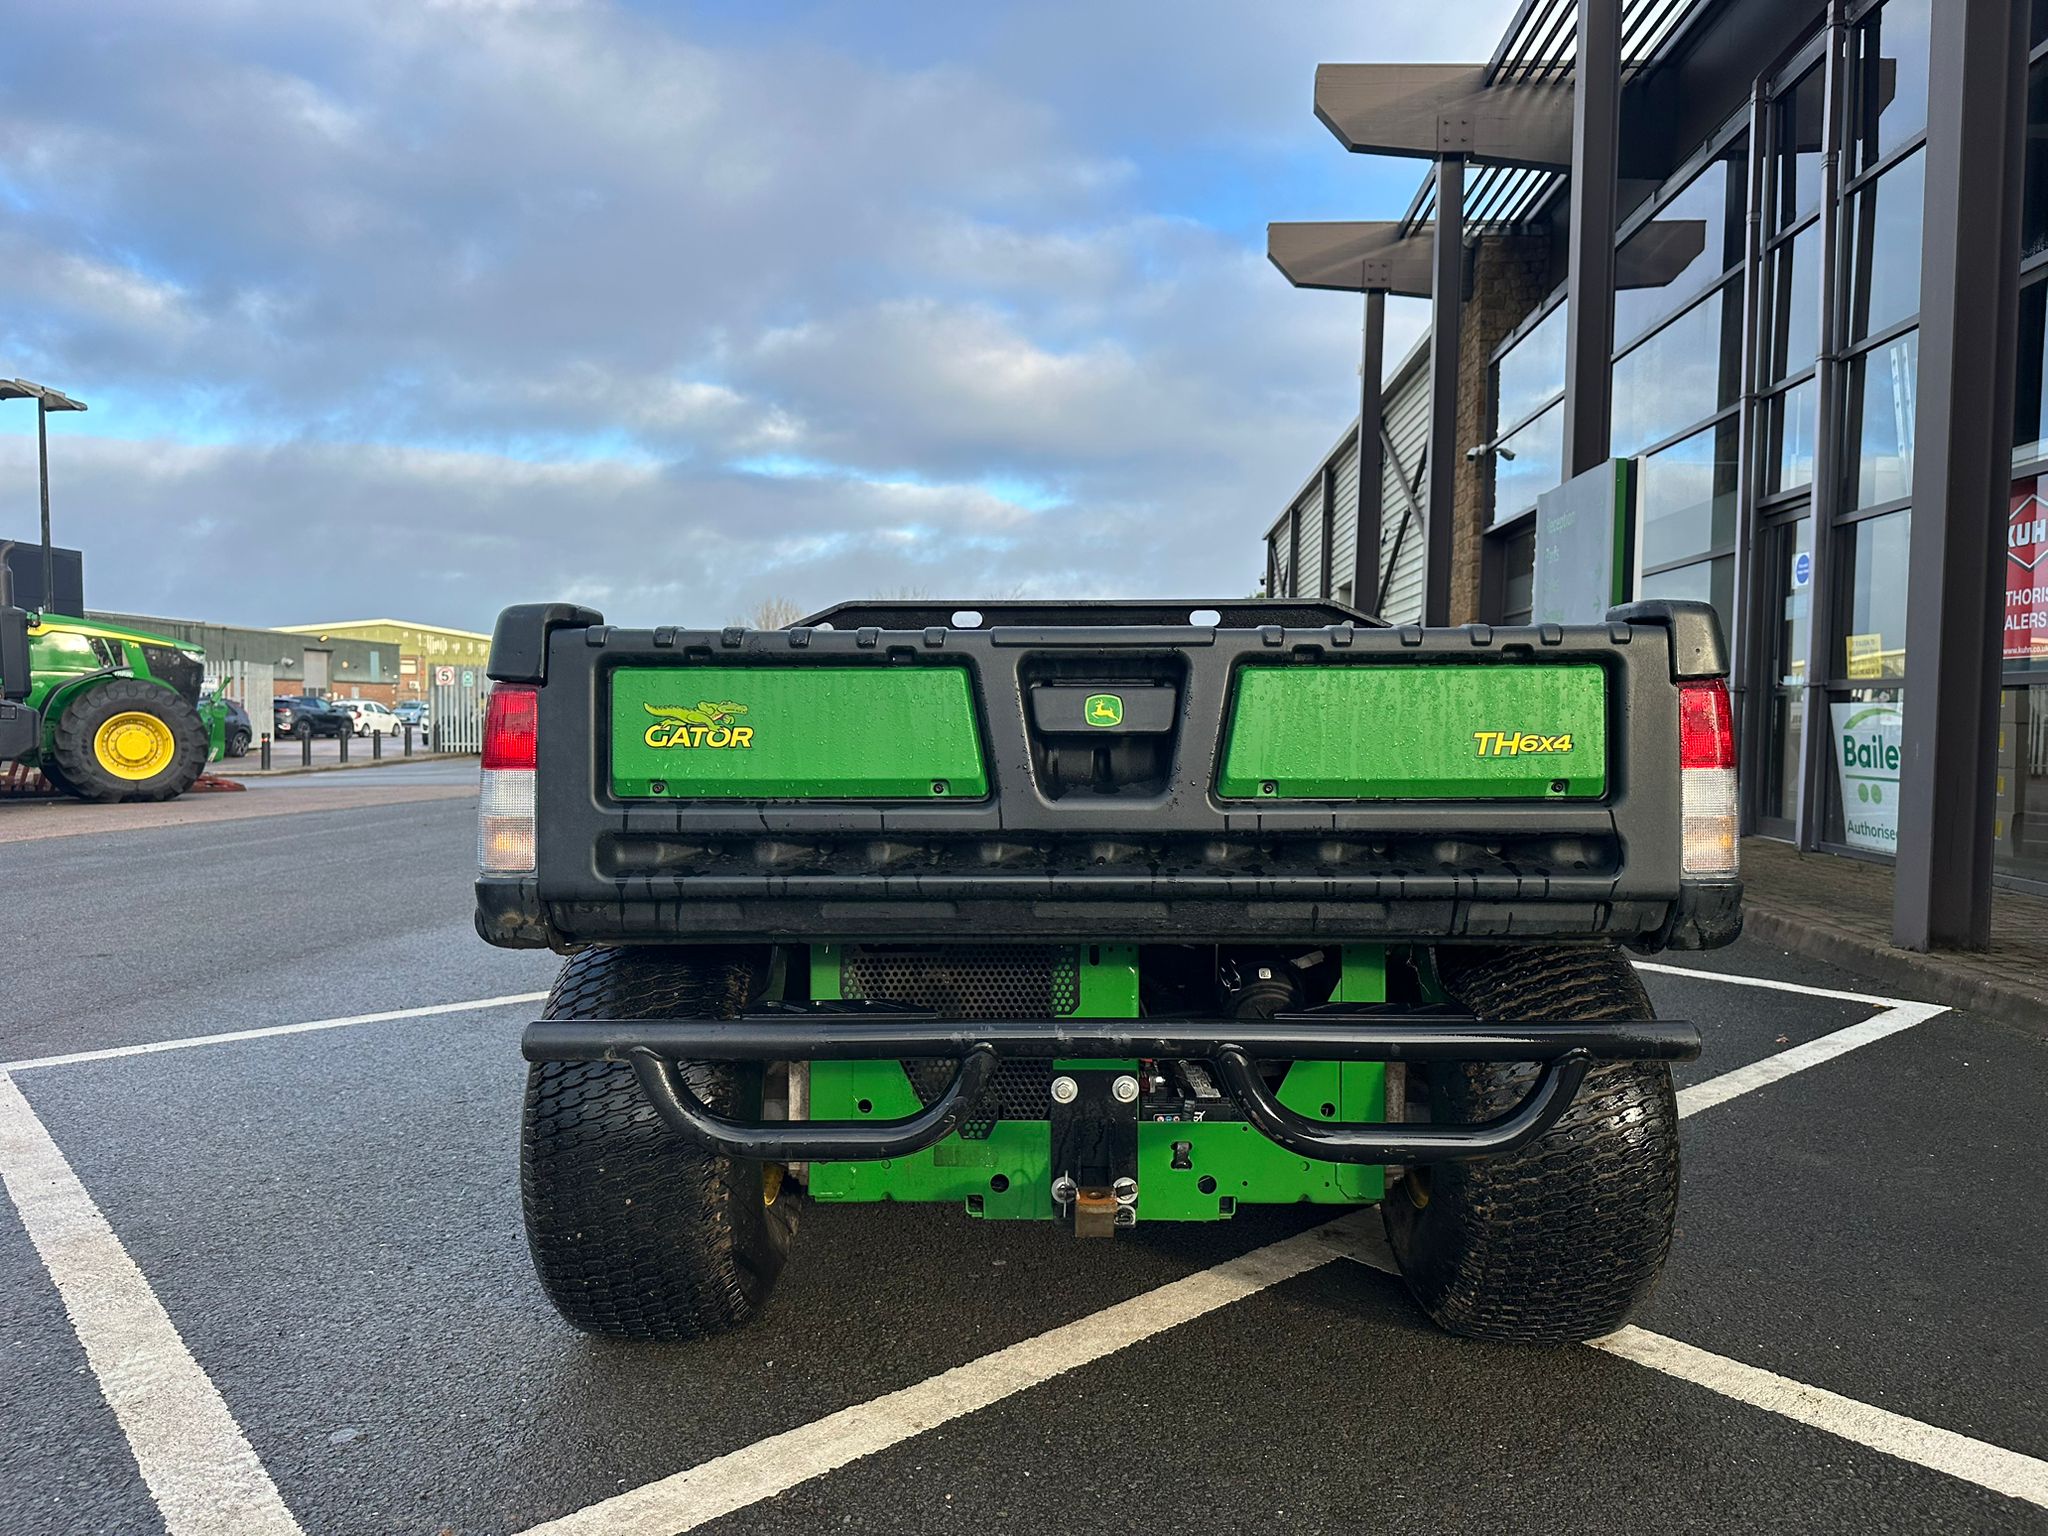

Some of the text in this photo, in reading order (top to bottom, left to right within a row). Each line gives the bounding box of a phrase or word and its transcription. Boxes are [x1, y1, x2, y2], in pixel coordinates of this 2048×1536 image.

[441, 671, 449, 681] 5
[644, 724, 754, 748] GATOR
[1843, 734, 1901, 770] Baile
[1847, 819, 1897, 841] Authorise
